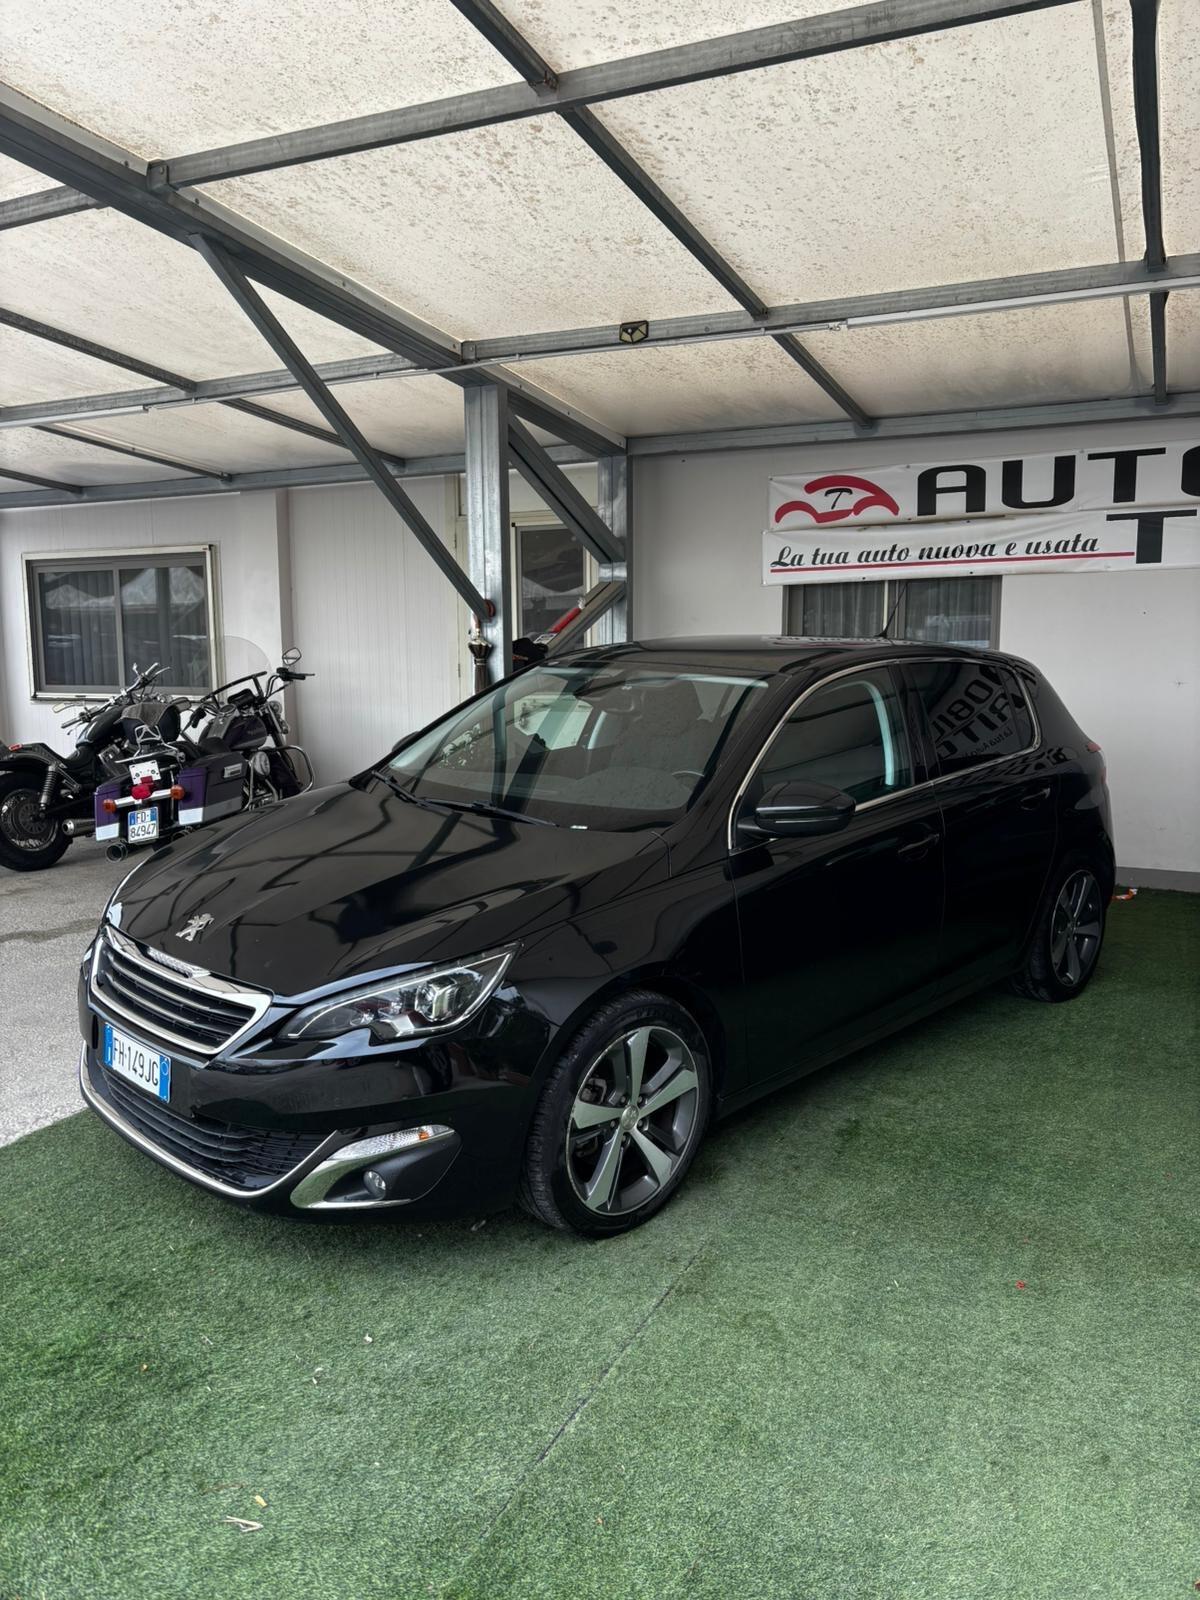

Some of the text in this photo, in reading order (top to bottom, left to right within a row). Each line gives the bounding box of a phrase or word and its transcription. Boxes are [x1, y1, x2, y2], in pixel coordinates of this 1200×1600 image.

[917, 445, 1200, 517] AUT
[770, 533, 1100, 567] La tua auto nuova e usata
[1106, 509, 1197, 564] T
[130, 823, 156, 838] 84947
